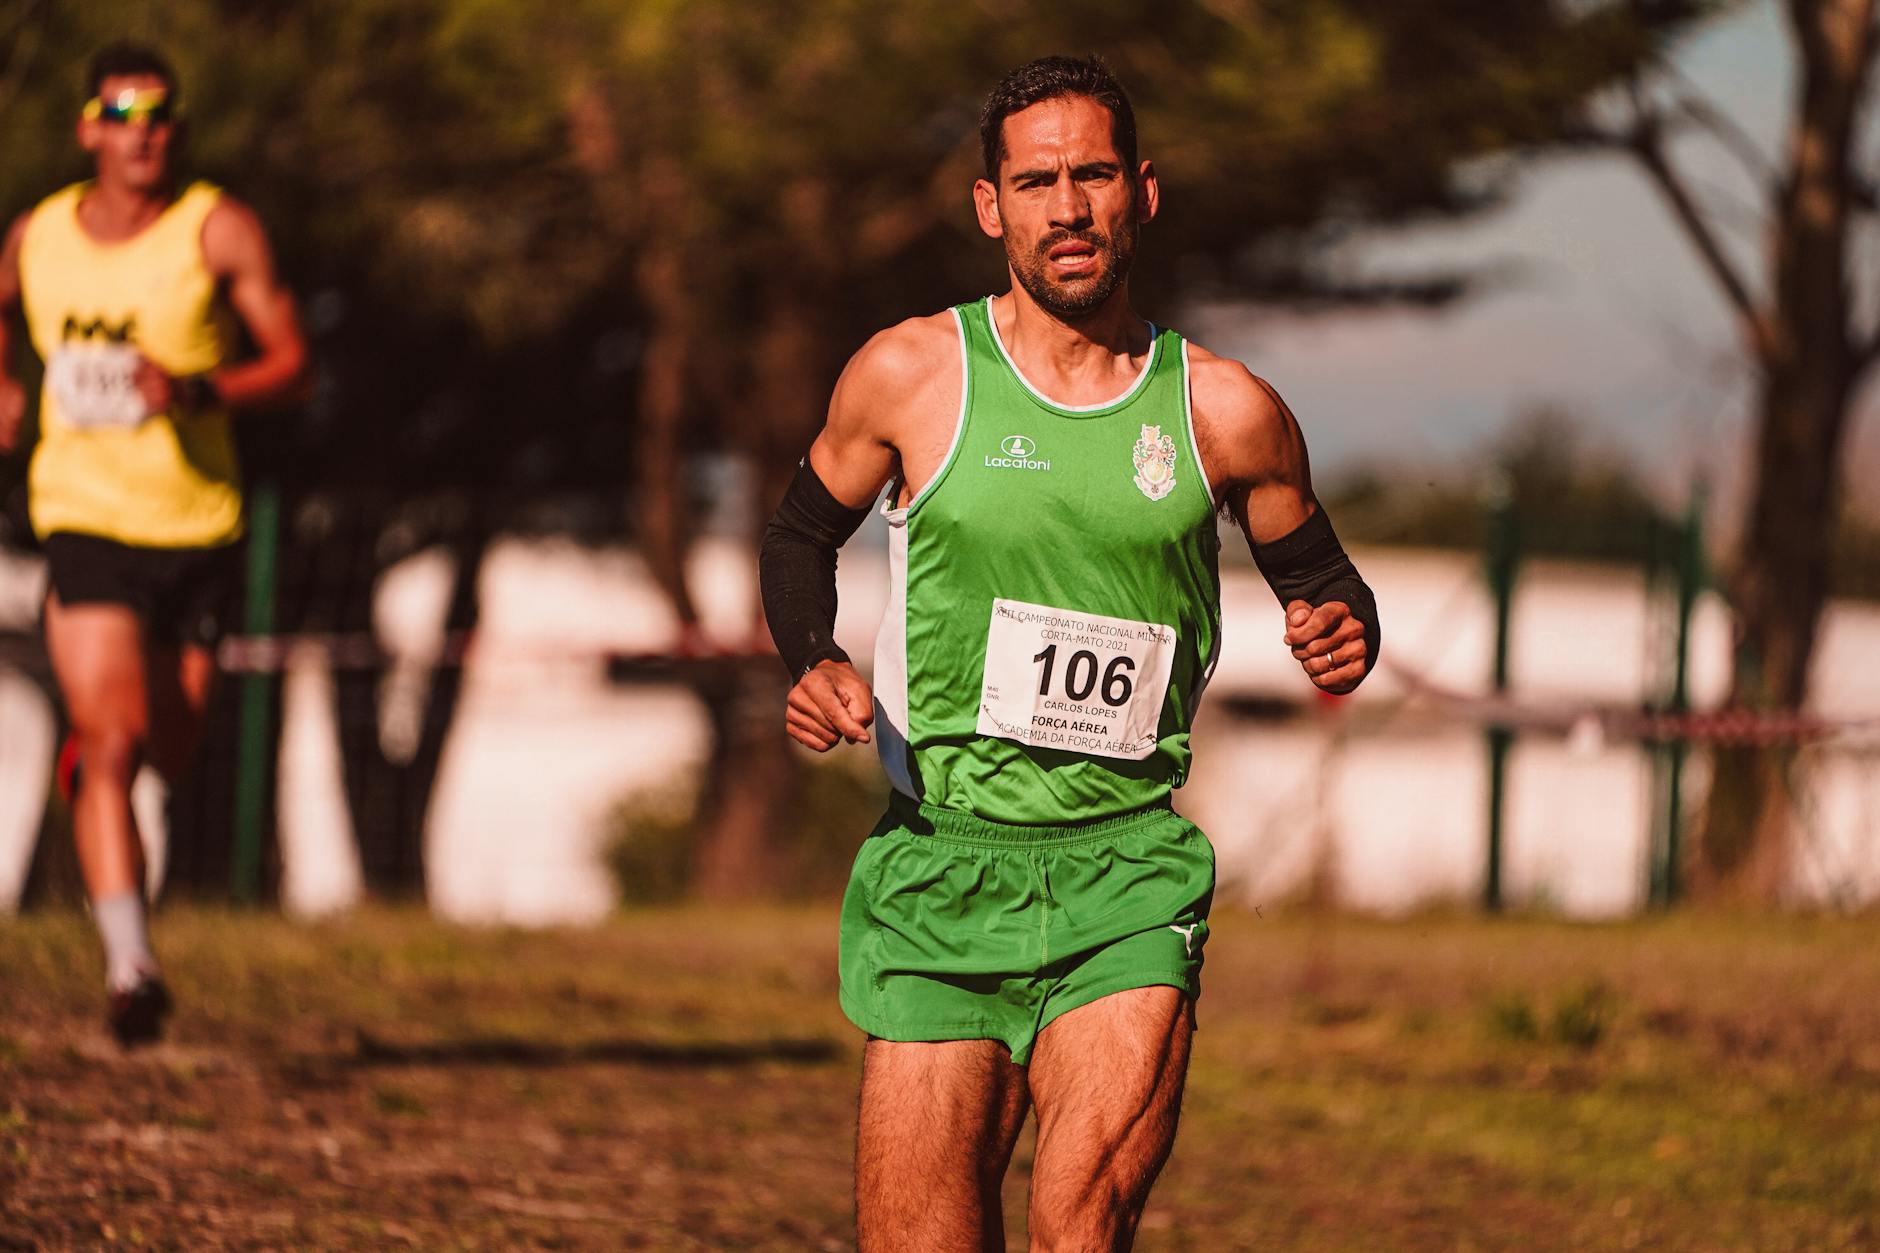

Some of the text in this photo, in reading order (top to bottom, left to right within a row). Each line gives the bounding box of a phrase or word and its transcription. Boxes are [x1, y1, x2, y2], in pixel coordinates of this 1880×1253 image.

[984, 455, 1051, 471] Lacatoni
[1018, 611, 1084, 631] CAMPEONATO
[1086, 623, 1134, 639] NACIONAL
[1040, 629, 1128, 652] CORTA-MATO 2021
[1033, 644, 1135, 707] 106
[1044, 700, 1118, 719] CARLOS LOPES
[1031, 715, 1108, 736] FORÇA AÉREA
[998, 722, 1137, 755] ACADEMIA DA FORÇA AÉREA
